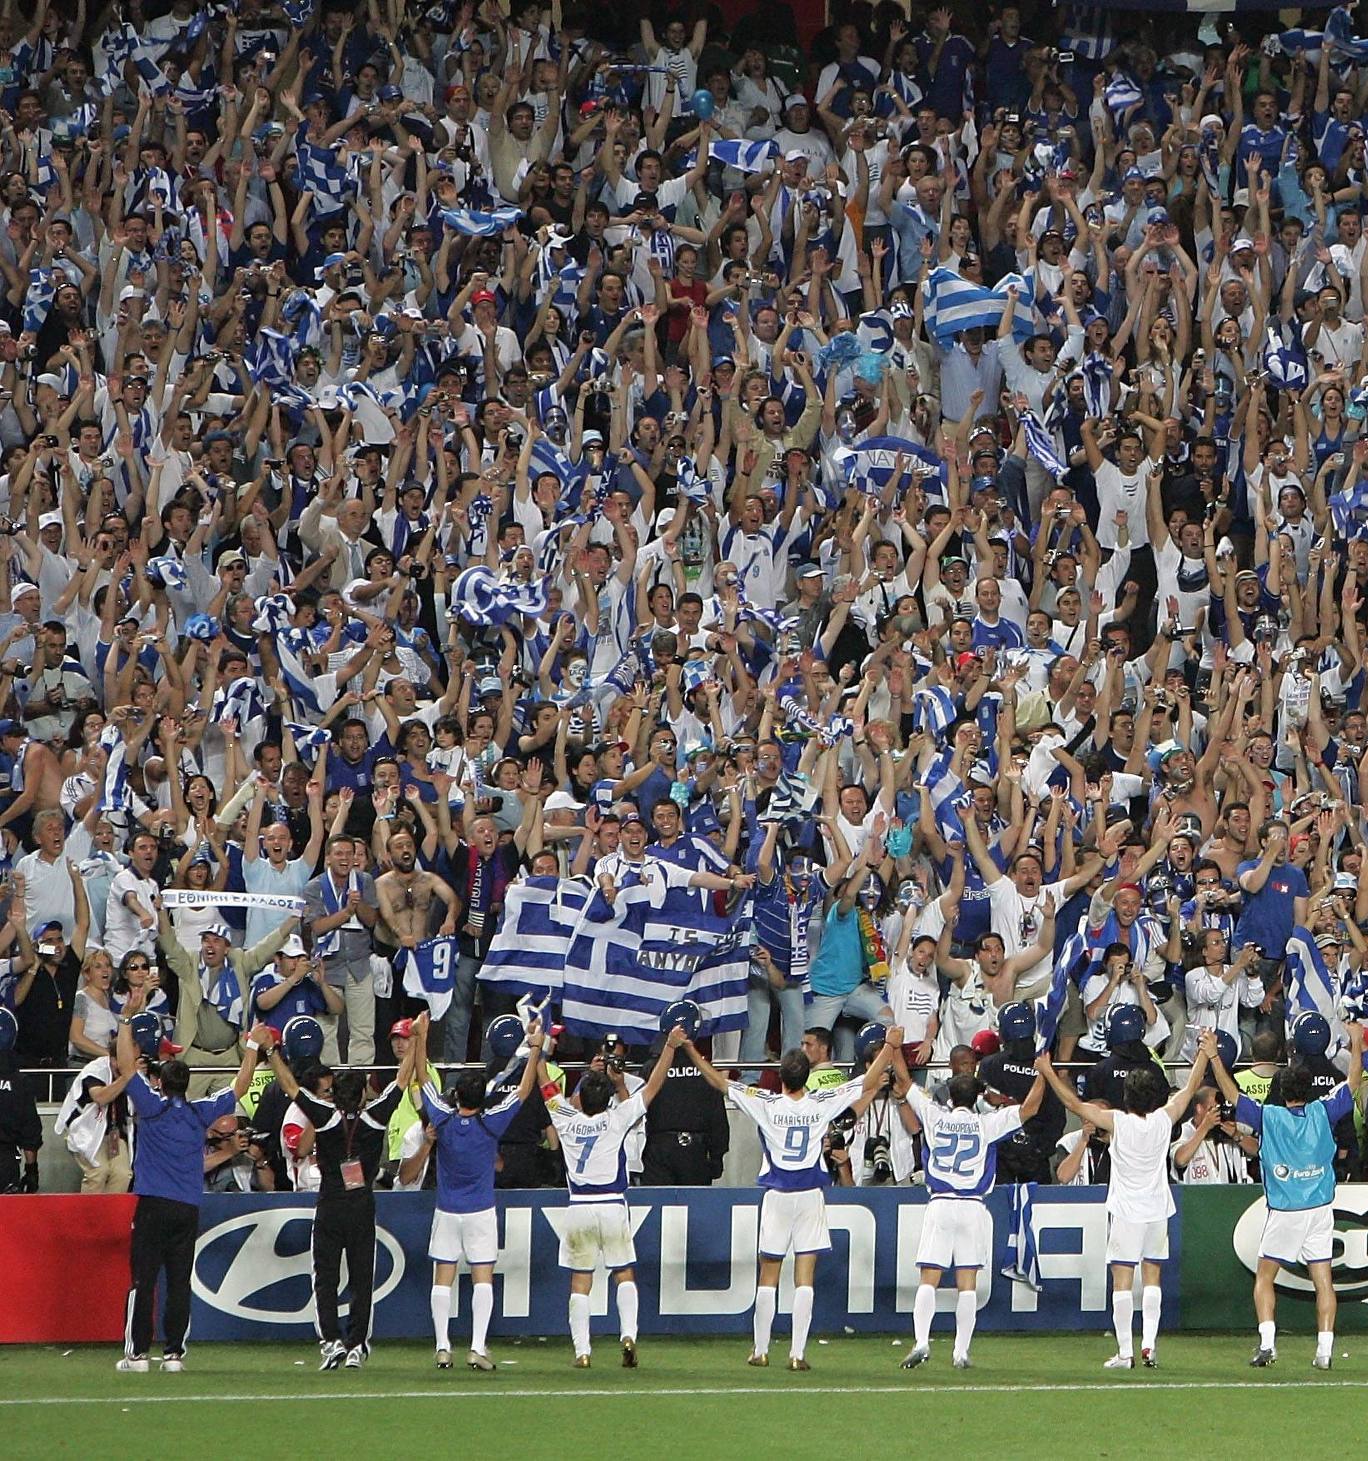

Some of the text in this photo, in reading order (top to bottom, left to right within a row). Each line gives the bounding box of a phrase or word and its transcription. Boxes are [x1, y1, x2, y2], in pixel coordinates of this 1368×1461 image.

[432, 941, 451, 979] 9
[773, 1113, 820, 1127] CHARISTEAS
[575, 1135, 600, 1175] 7
[782, 1126, 810, 1162] 9
[932, 1131, 980, 1177] 22
